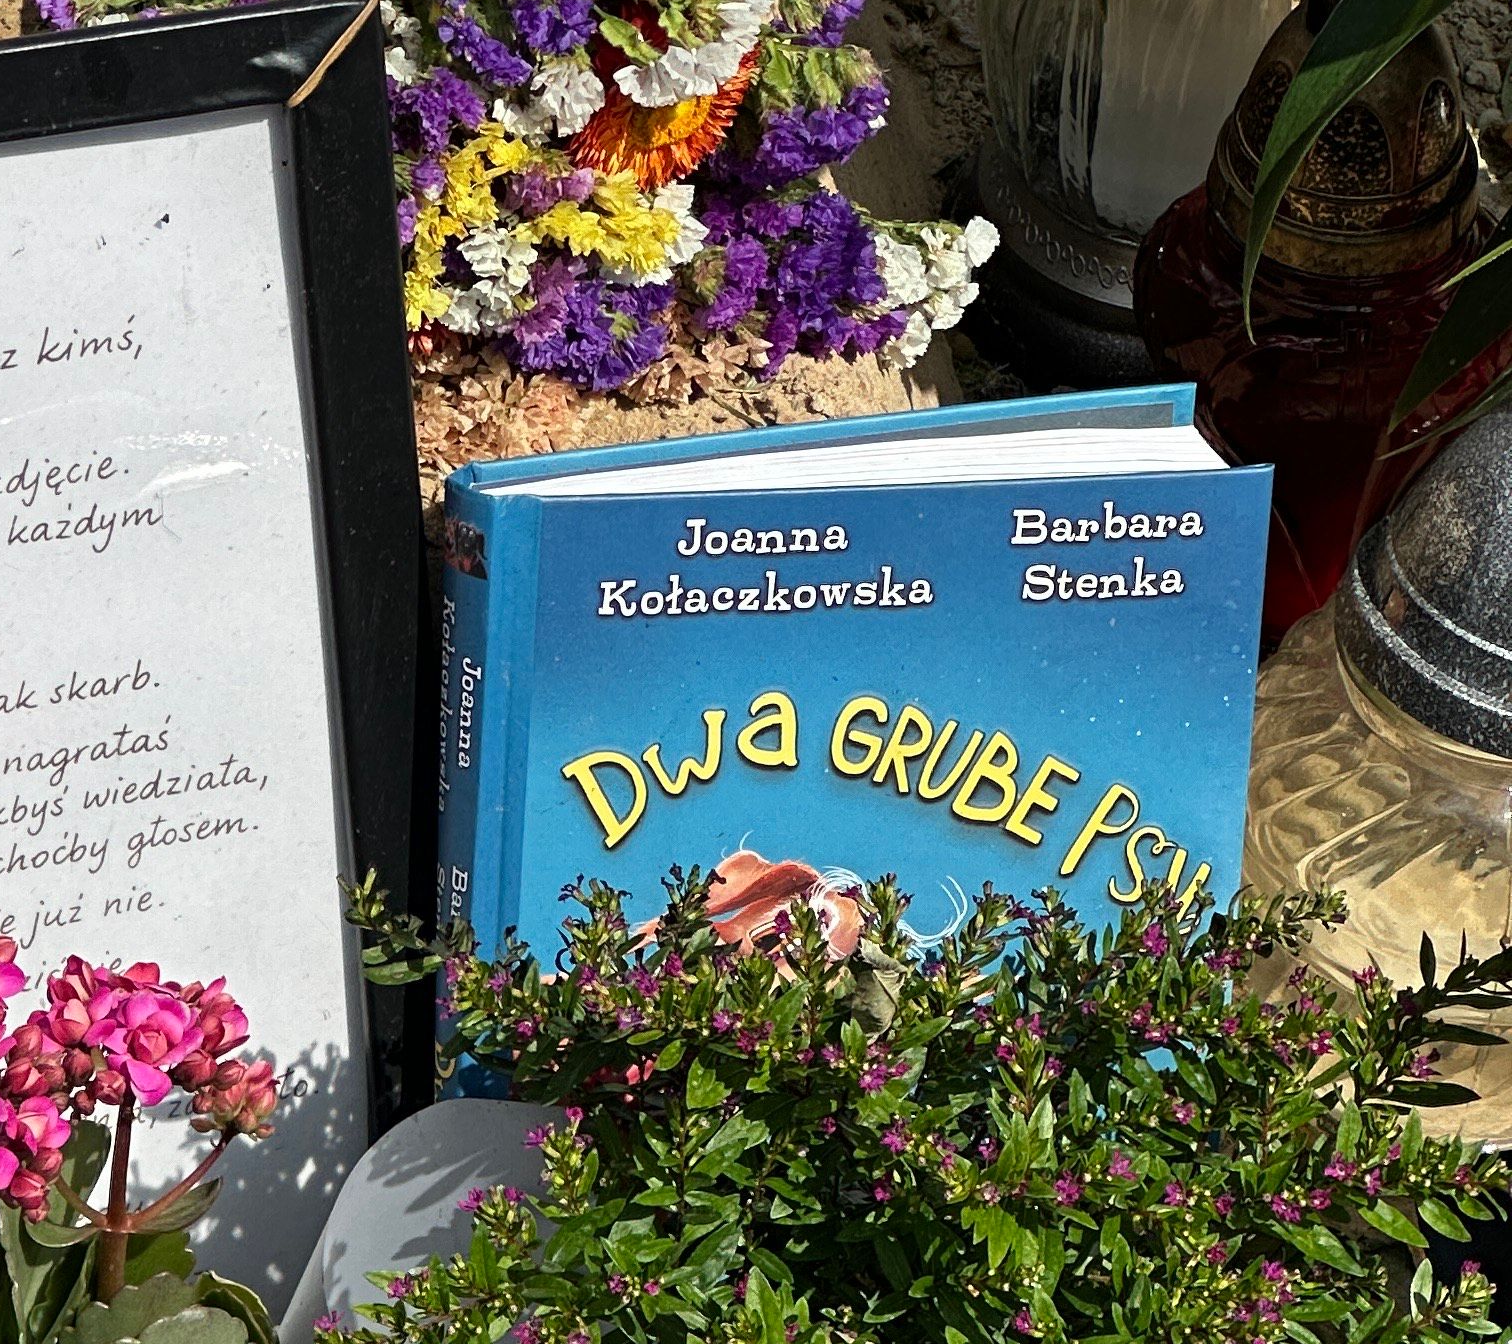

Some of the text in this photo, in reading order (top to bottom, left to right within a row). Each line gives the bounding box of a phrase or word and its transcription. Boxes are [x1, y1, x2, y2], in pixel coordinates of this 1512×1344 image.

[0, 349, 18, 370] z
[37, 314, 142, 365] kimś,
[8, 503, 163, 553] każdym
[676, 507, 1205, 558] Joanna Barbara
[598, 561, 1186, 618] Kołaczkowska Stenka
[50, 659, 160, 704] skarb.
[457, 657, 482, 769] Joanna
[3, 716, 174, 786] nagrałaś
[560, 690, 799, 852] Dwa
[829, 695, 1081, 846] GRUBE
[83, 754, 268, 809] wiedziała,
[127, 816, 259, 869] głosem.
[20, 893, 82, 949] już
[104, 892, 164, 916] nie.
